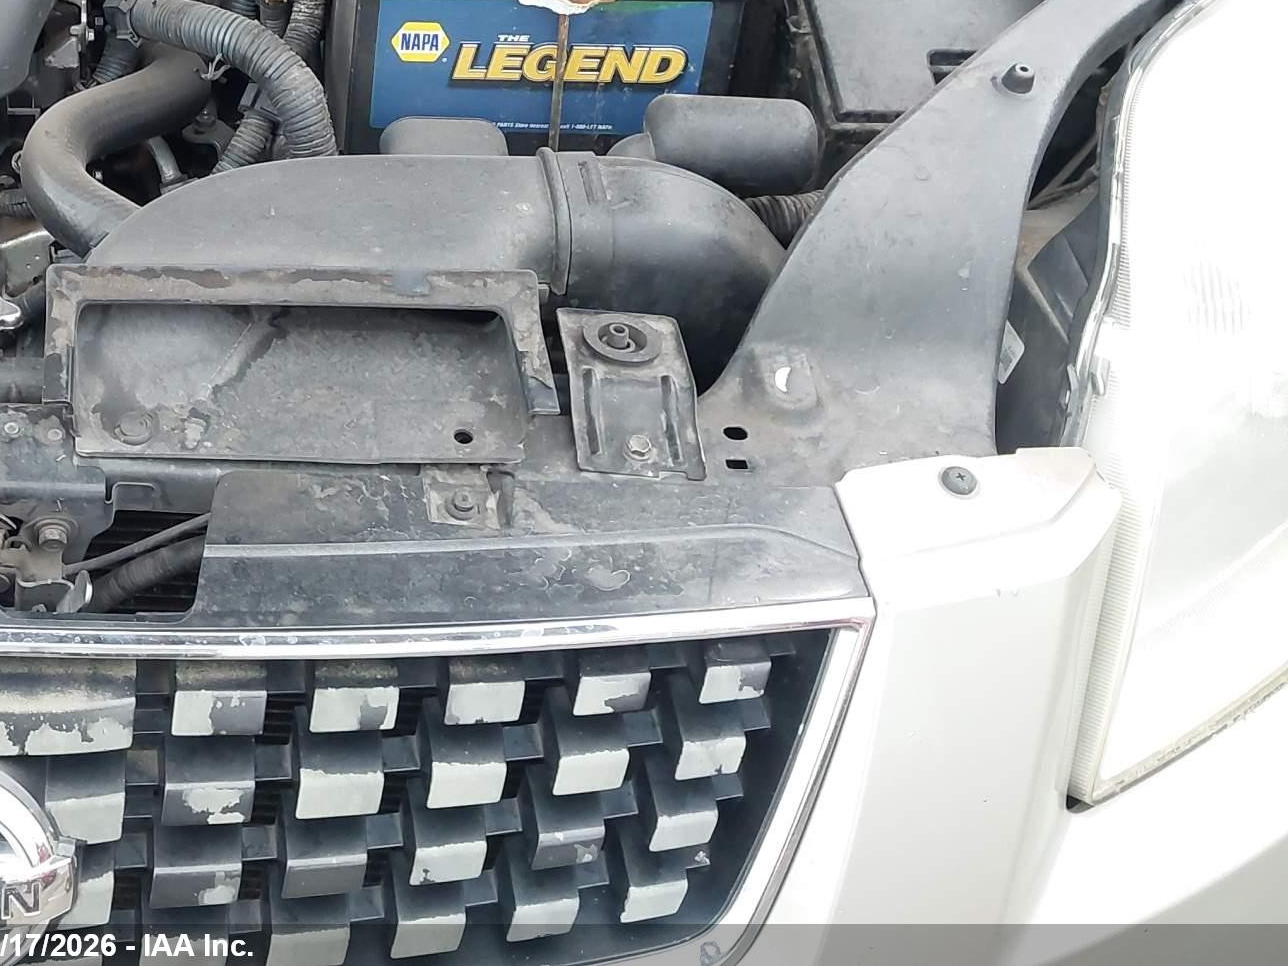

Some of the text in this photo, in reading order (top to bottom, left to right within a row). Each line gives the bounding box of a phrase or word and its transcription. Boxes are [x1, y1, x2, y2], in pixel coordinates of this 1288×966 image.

[400, 33, 440, 51] NAPA
[497, 34, 531, 42] THE
[451, 42, 688, 84] LEGEND
